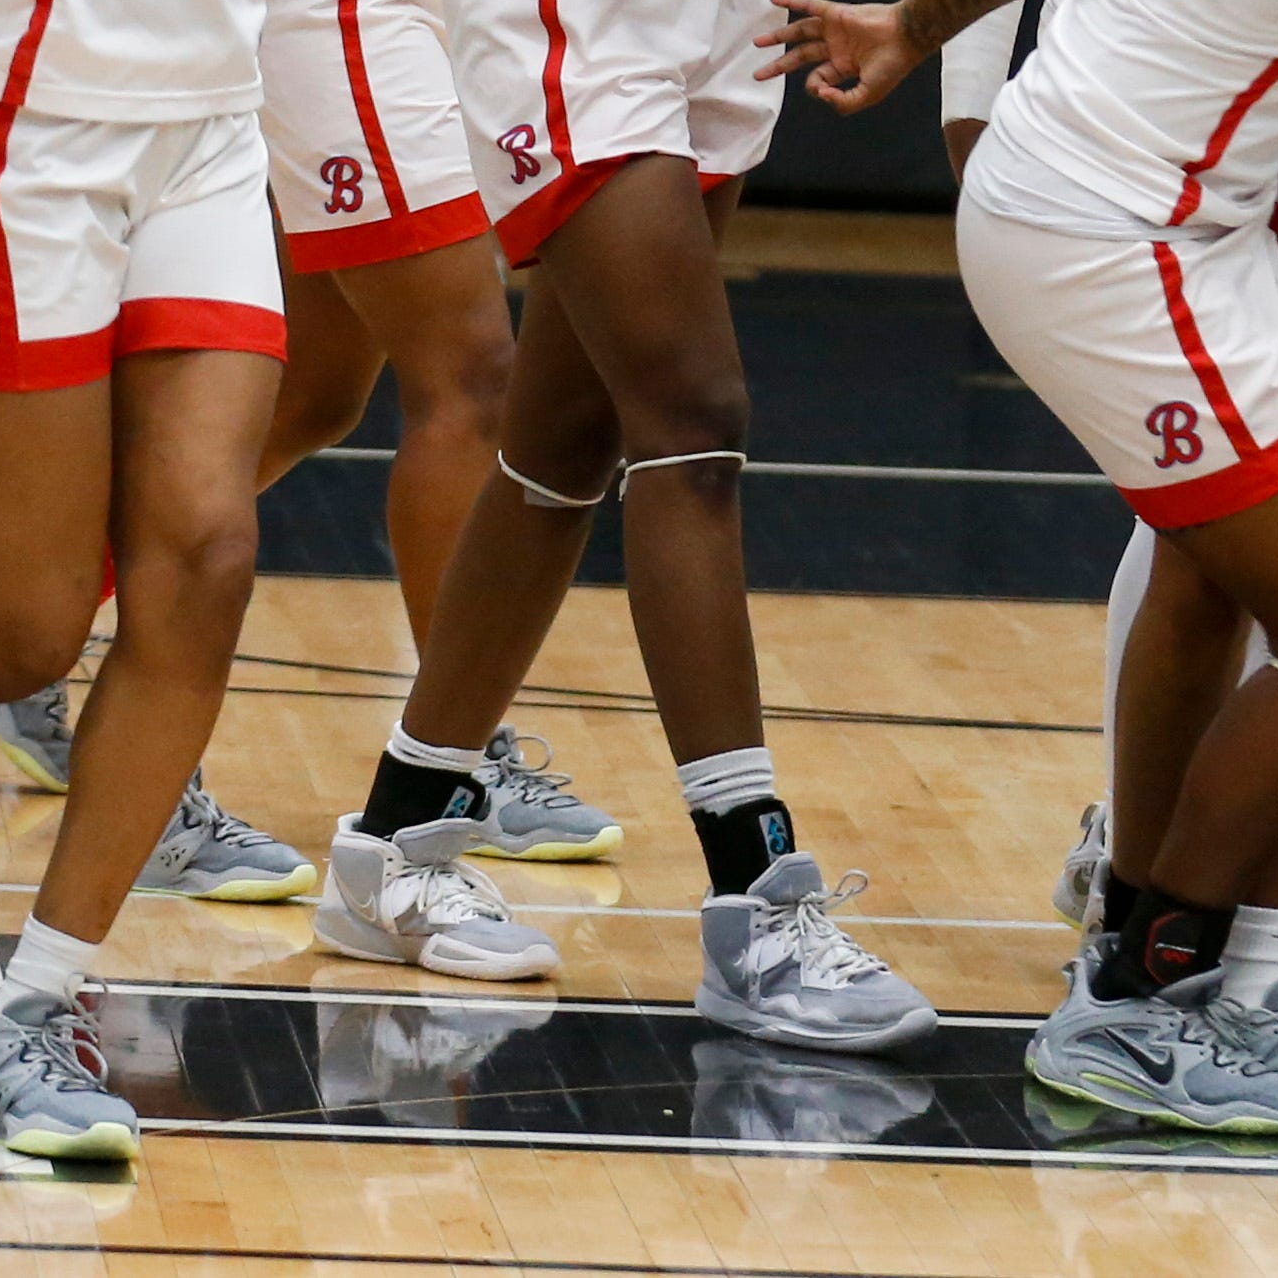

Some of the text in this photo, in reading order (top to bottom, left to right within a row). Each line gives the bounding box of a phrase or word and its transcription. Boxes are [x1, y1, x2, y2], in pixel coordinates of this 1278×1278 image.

[497, 124, 541, 184] B
[320, 156, 363, 214] B
[1145, 401, 1203, 469] B
